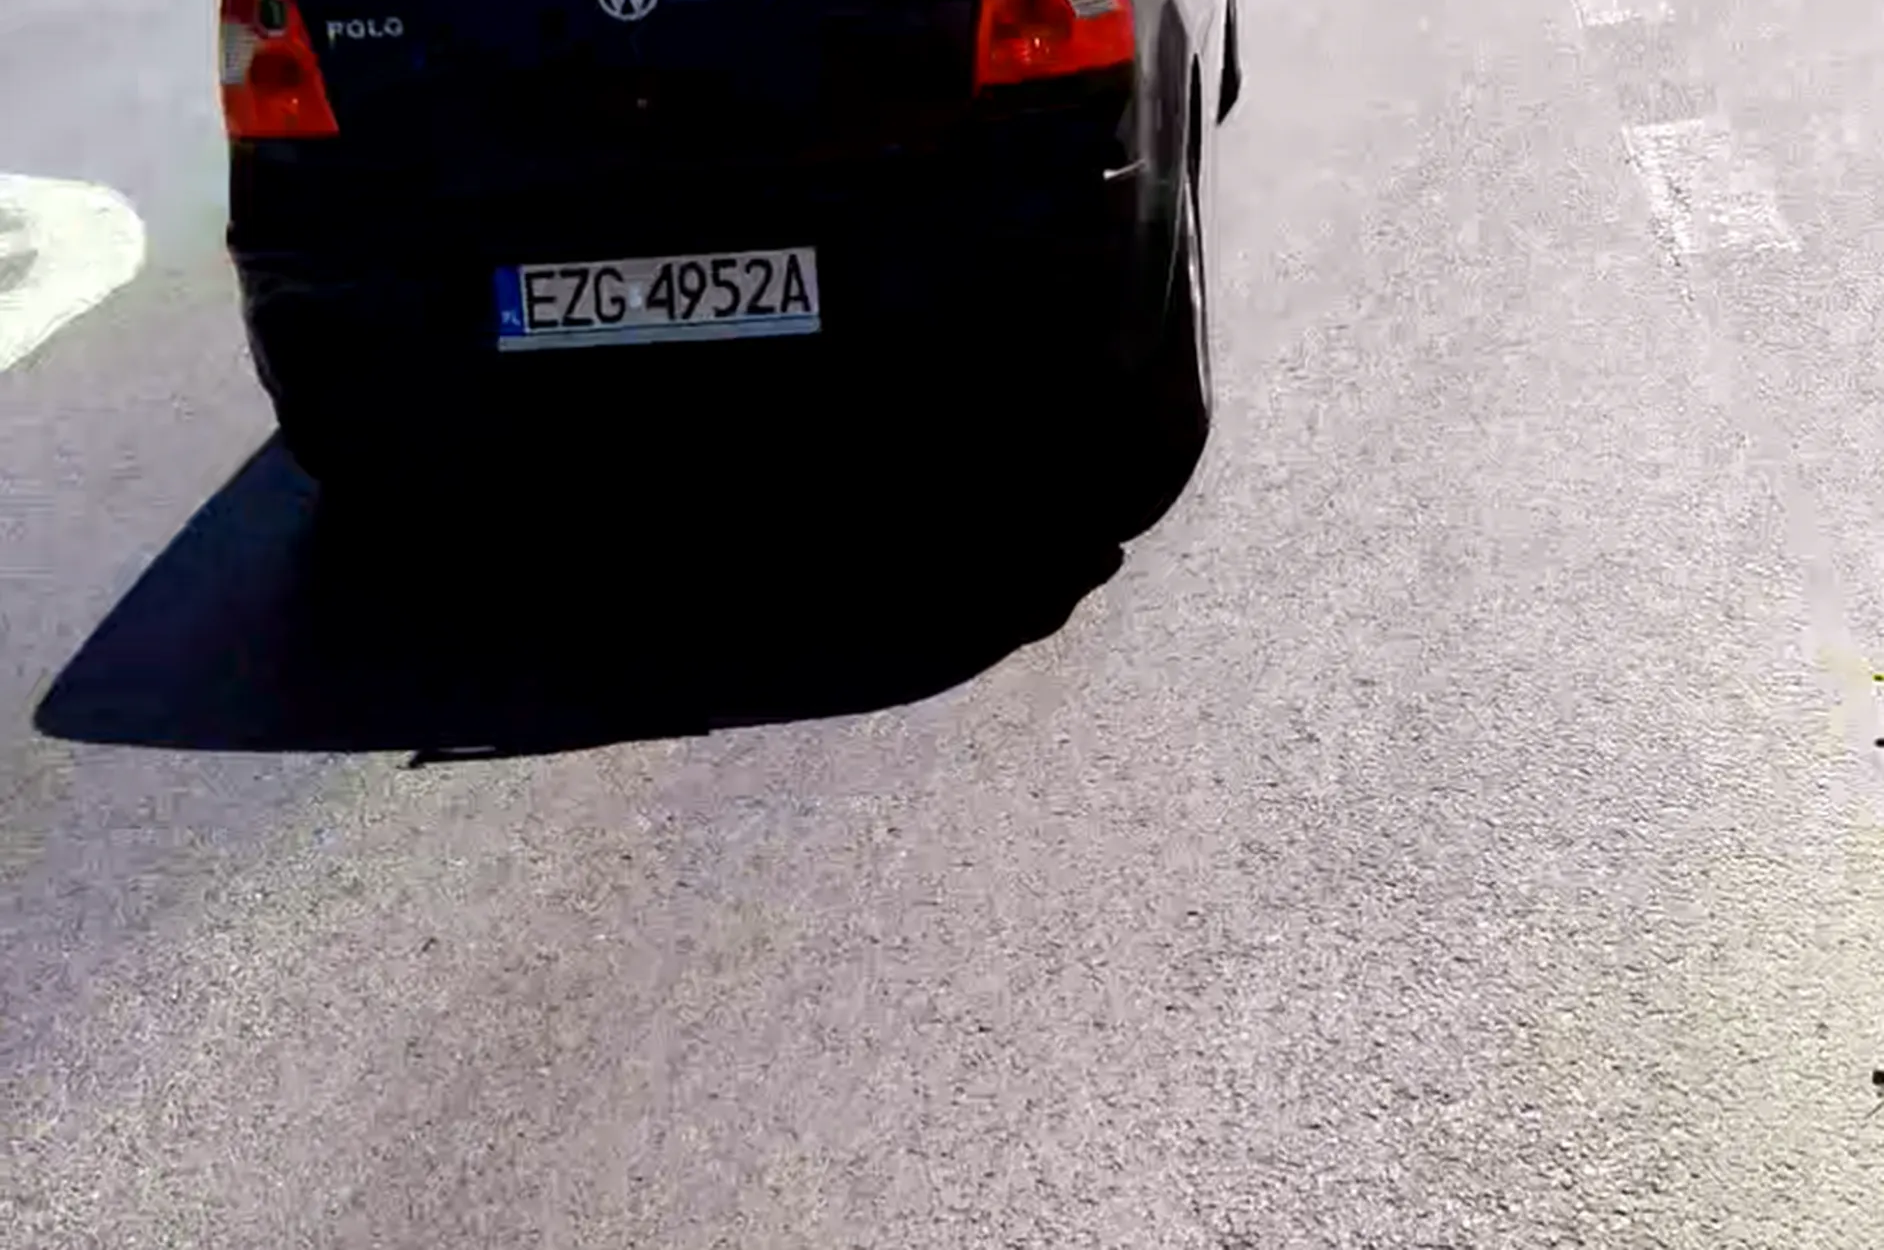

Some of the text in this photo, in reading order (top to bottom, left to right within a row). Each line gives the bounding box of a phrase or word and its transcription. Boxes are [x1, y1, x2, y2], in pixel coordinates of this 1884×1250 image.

[326, 17, 404, 40] POLO
[524, 253, 812, 330] EZG 4952A
